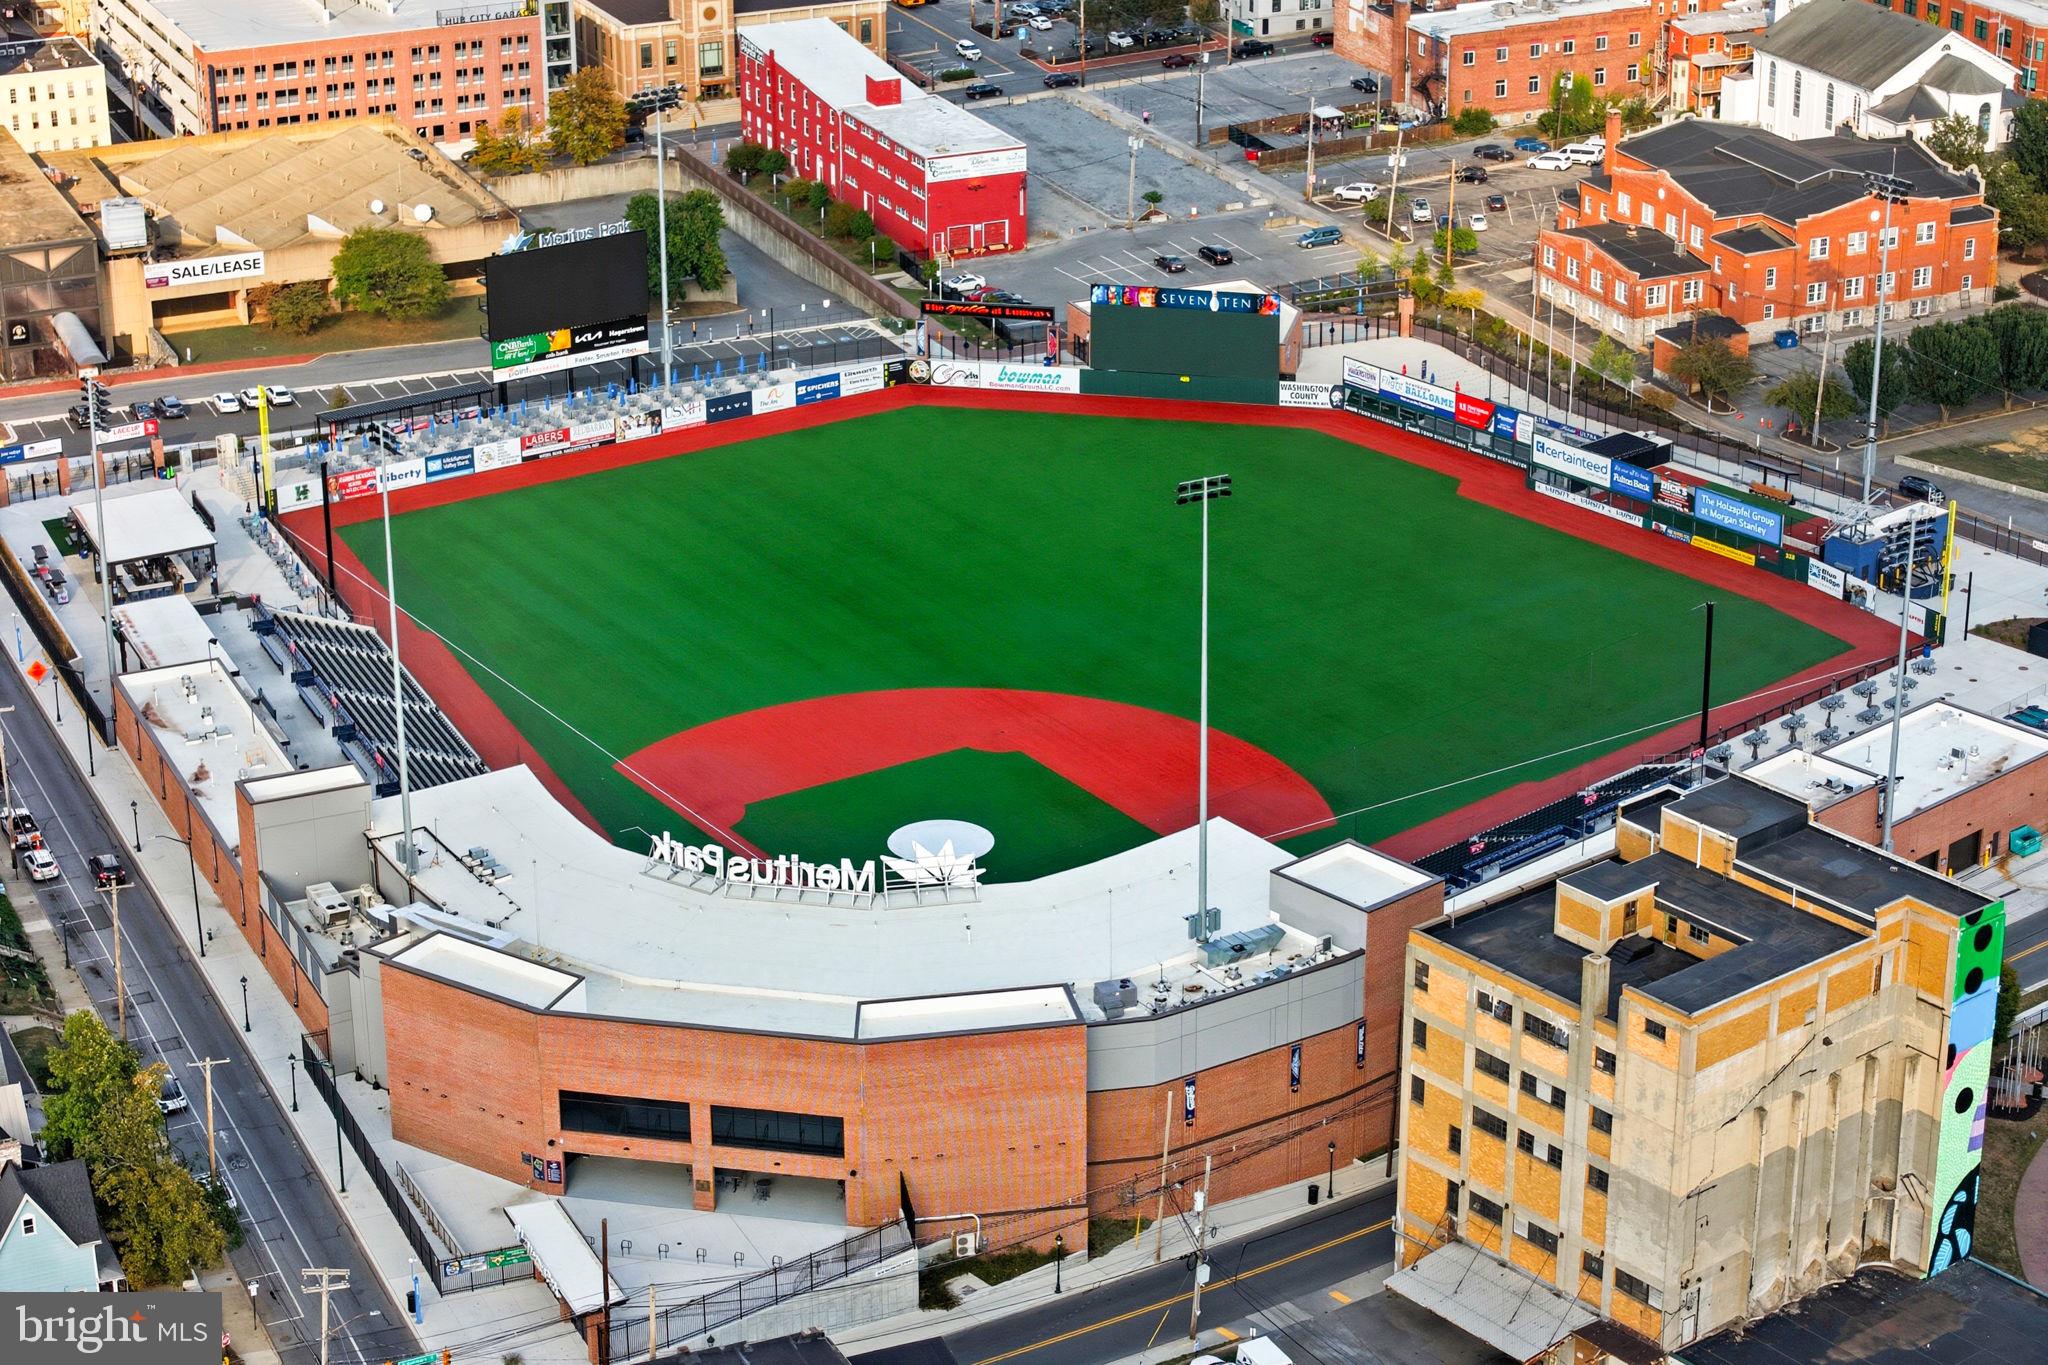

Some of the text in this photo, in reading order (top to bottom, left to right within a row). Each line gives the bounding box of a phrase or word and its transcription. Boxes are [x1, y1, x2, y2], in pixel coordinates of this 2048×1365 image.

[445, 16, 465, 25] HUB
[470, 13, 491, 23] CITY
[539, 219, 632, 248] Meritus Park
[172, 258, 262, 279] SALE/LEASE
[1161, 293, 1252, 309] SEVEN TEN
[998, 365, 1062, 385] bowman
[1280, 383, 1329, 393] WASHINGTON
[1289, 392, 1319, 400] COUNTY
[709, 401, 748, 413] VOLVO
[525, 430, 564, 447] LABERS
[1545, 444, 1608, 475] certainteed
[379, 469, 422, 483] Liberty
[1580, 497, 1606, 511] VARSITY
[1615, 509, 1641, 523] VARSITY
[1701, 494, 1715, 506] The
[1716, 498, 1751, 519] Holzapfel
[1752, 512, 1775, 527] Group
[1700, 508, 1767, 537] at Morgan Stanley
[1821, 568, 1837, 580] Blue
[1821, 575, 1841, 589] Ridge
